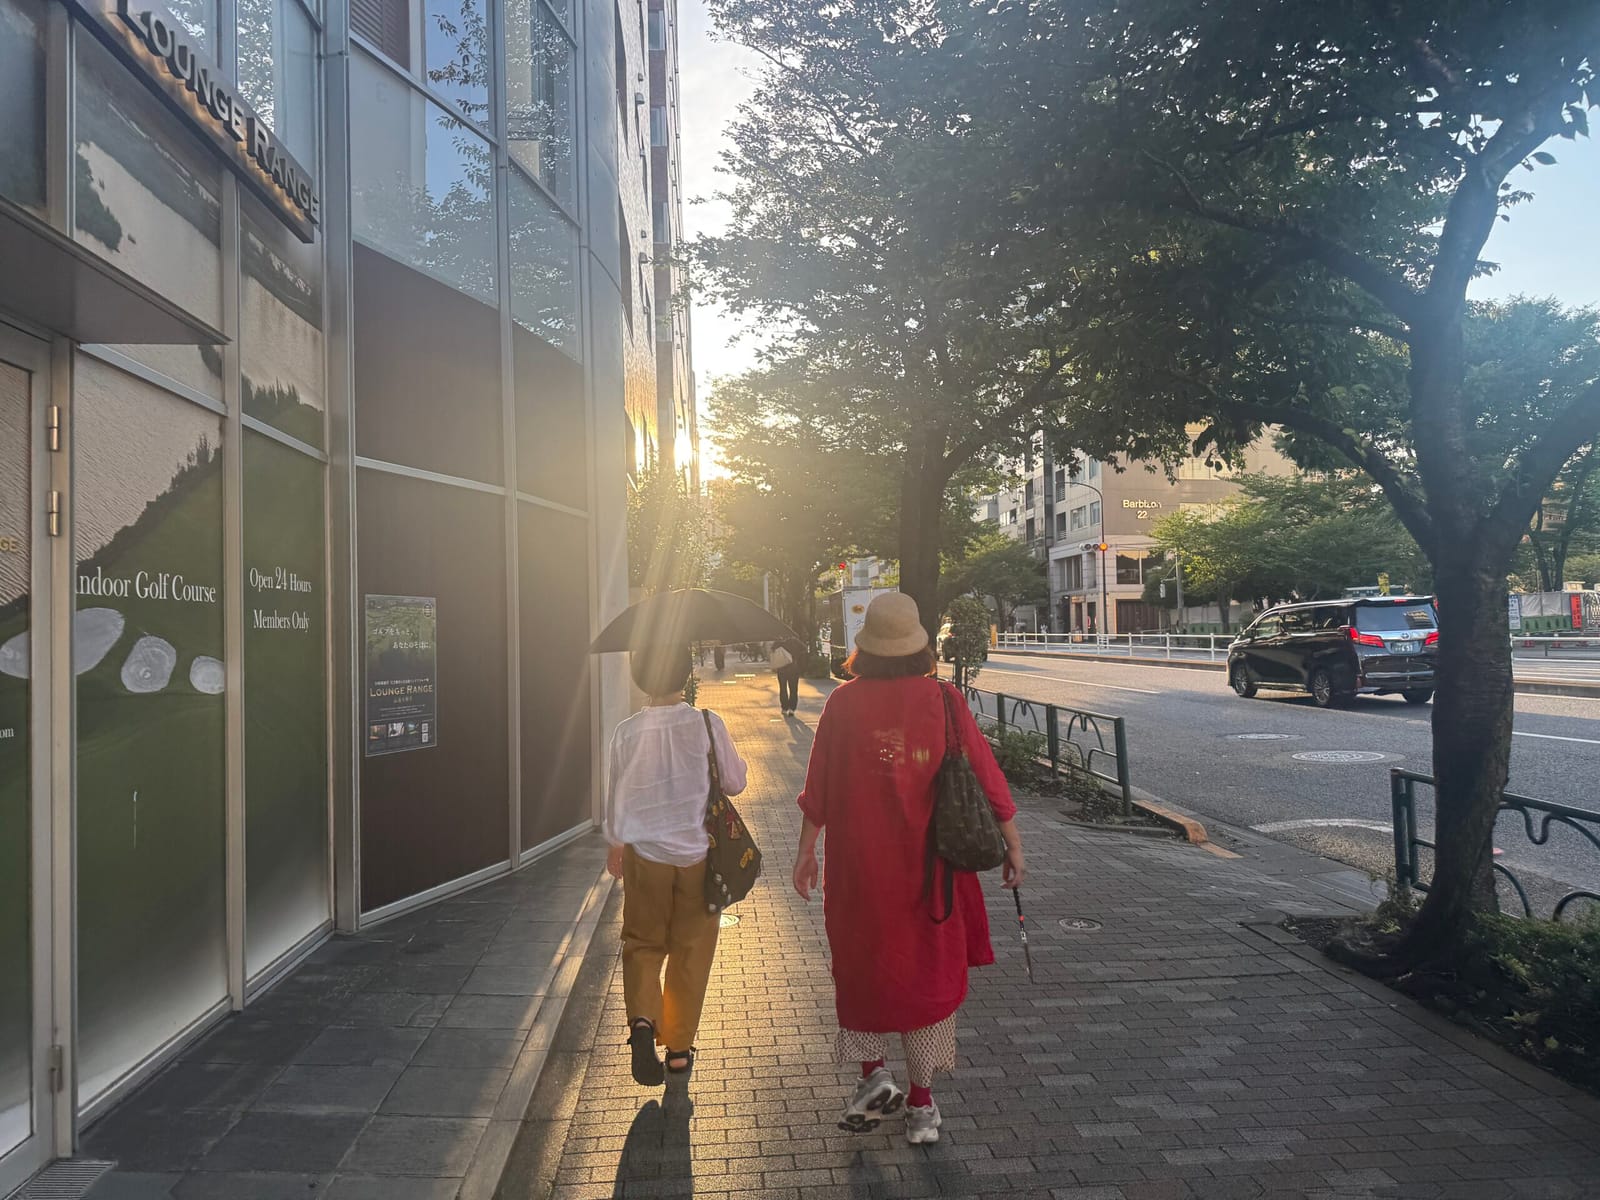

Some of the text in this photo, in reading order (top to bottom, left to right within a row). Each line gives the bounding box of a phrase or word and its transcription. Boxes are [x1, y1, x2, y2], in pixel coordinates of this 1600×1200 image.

[247, 117, 319, 224] RANGE
[1137, 510, 1148, 519] 22
[135, 570, 169, 600] Golf
[172, 574, 216, 602] Course
[250, 566, 311, 592] Open 24 Hours
[253, 609, 310, 632] Members Only
[370, 684, 433, 697] LOUNGE RANGE
